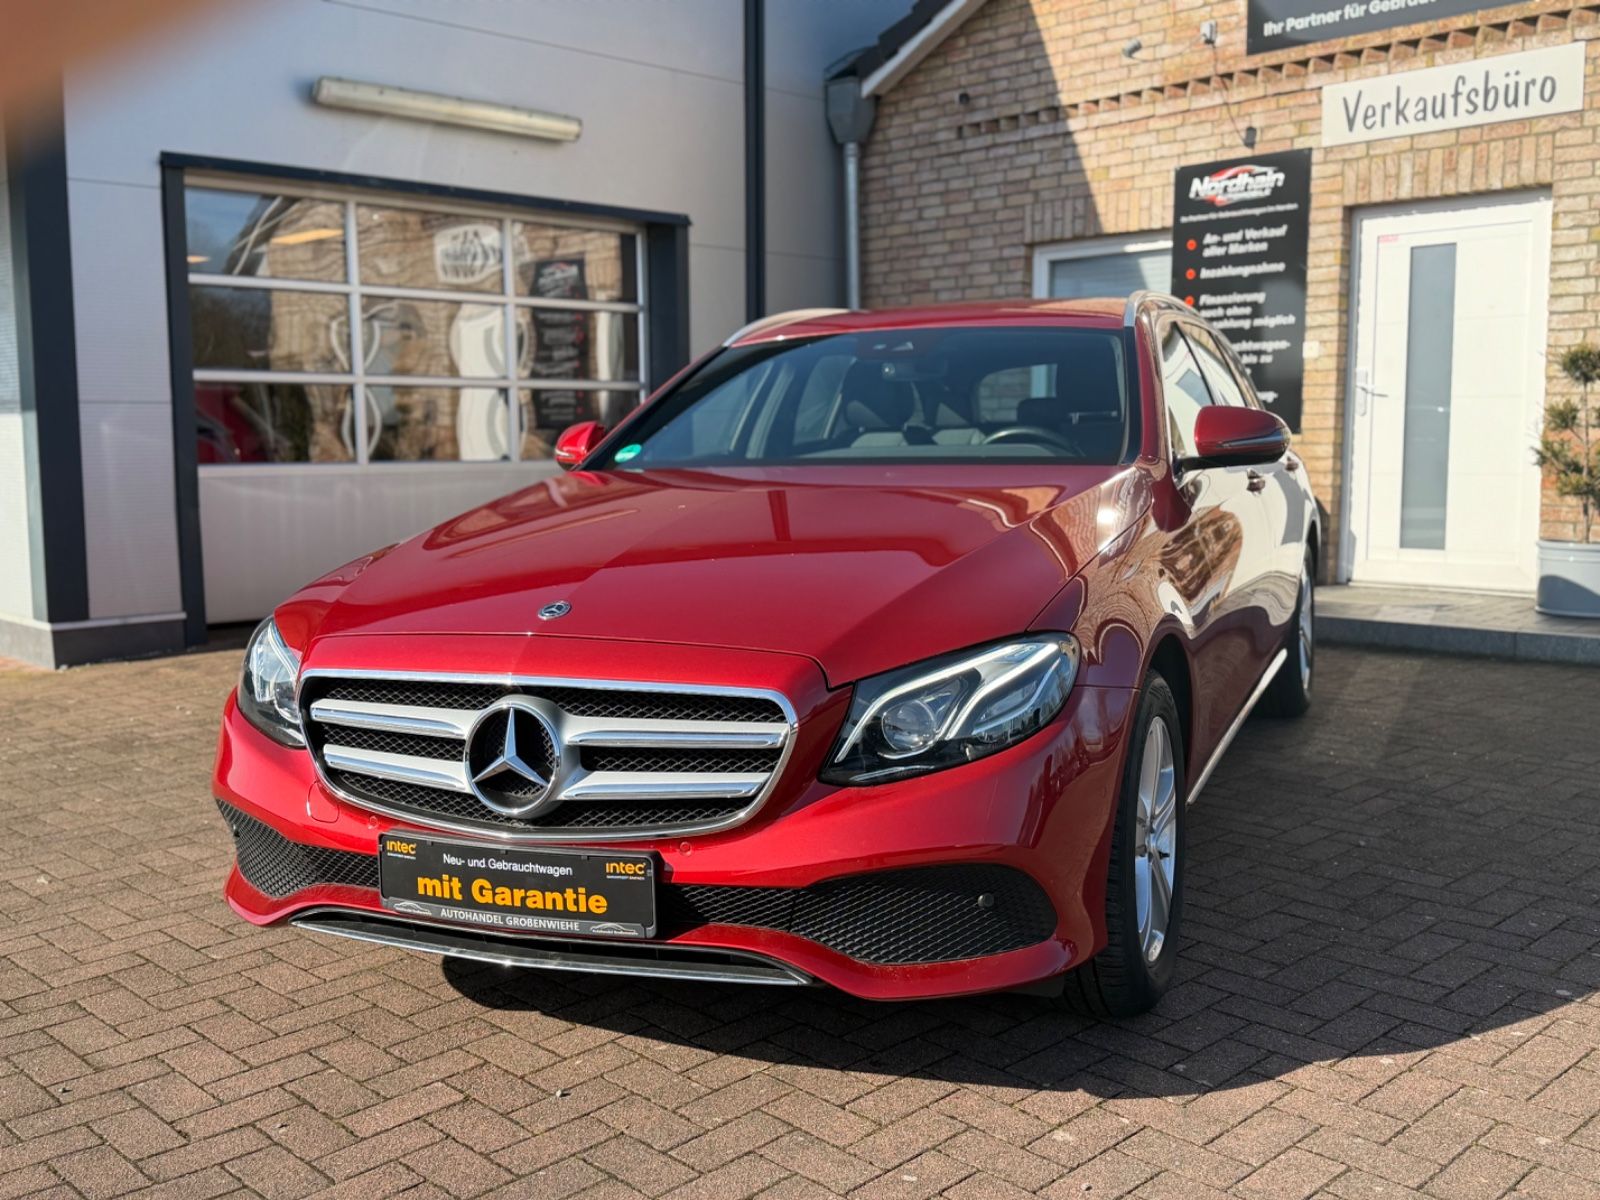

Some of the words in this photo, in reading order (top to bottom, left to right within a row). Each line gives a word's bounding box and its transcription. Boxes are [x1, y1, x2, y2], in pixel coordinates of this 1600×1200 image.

[1263, 23, 1284, 36] Ihr
[1285, 12, 1341, 32] Partner
[1344, 4, 1367, 19] für
[1342, 70, 1557, 133] Verkaufsbüro
[386, 840, 417, 855] intec
[443, 853, 465, 866] Neu-
[467, 859, 487, 868] und
[488, 858, 573, 877] Gebrauchtwagen
[606, 862, 646, 875] intec
[417, 875, 463, 901] mit
[471, 878, 608, 914] Garantie
[440, 908, 504, 925] AUTOHANDEL
